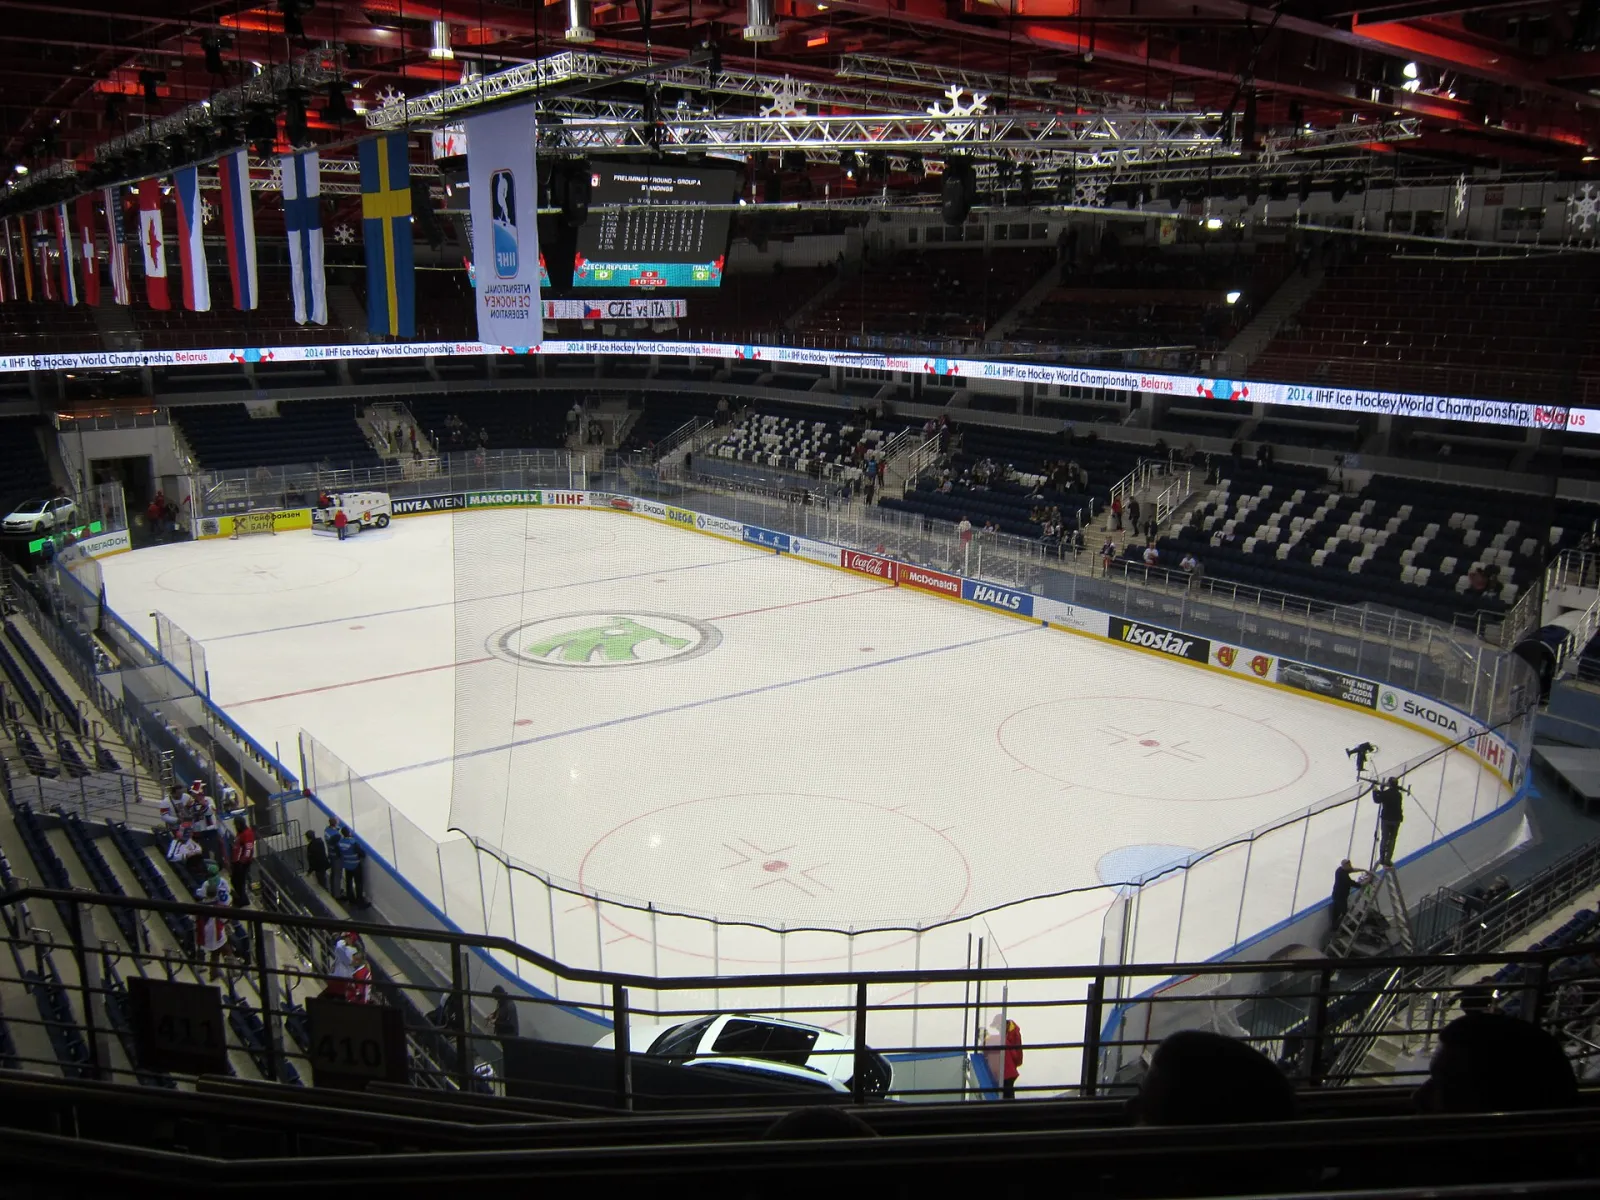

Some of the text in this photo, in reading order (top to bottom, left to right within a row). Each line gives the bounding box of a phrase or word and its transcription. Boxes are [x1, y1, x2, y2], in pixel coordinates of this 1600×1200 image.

[608, 302, 665, 317] CZE vs ITA
[304, 344, 483, 359] 2014 IIHF Ice Hockey World Championship, Belarus
[567, 343, 722, 356] 2014 IIHF Ice Hockey World Championship, Belarus
[10, 359, 26, 369] IIHF
[27, 358, 42, 368] Ice
[44, 357, 78, 370] Hockey
[80, 356, 107, 366] World
[109, 353, 174, 368] Championship,
[176, 352, 208, 362] Belarus
[778, 350, 790, 360] 2014
[800, 352, 808, 362] Ice
[809, 352, 828, 364] Hockey
[829, 353, 844, 364] World
[886, 357, 908, 368] Belarus
[984, 364, 1173, 392] 2014 IIHF Ice Hockey World Championship, Belarus
[1287, 388, 1586, 427] 2014 IIHF Ice Hockey World Championship, Belarus
[393, 496, 464, 514] NIVEA MEN
[470, 491, 539, 505] MAKROFLEX
[556, 492, 584, 505] IIHF
[250, 521, 275, 532] БАНК
[88, 536, 128, 553] МЕГАФОН
[910, 571, 958, 594] McDonald's
[972, 585, 1022, 612] HALLS
[1067, 606, 1074, 616] R
[1342, 678, 1374, 692] THE NEW
[1342, 692, 1372, 706] OCTAVIA
[1403, 700, 1457, 735] ŠKODA
[158, 1014, 218, 1048] 411
[318, 1034, 382, 1068] 410
